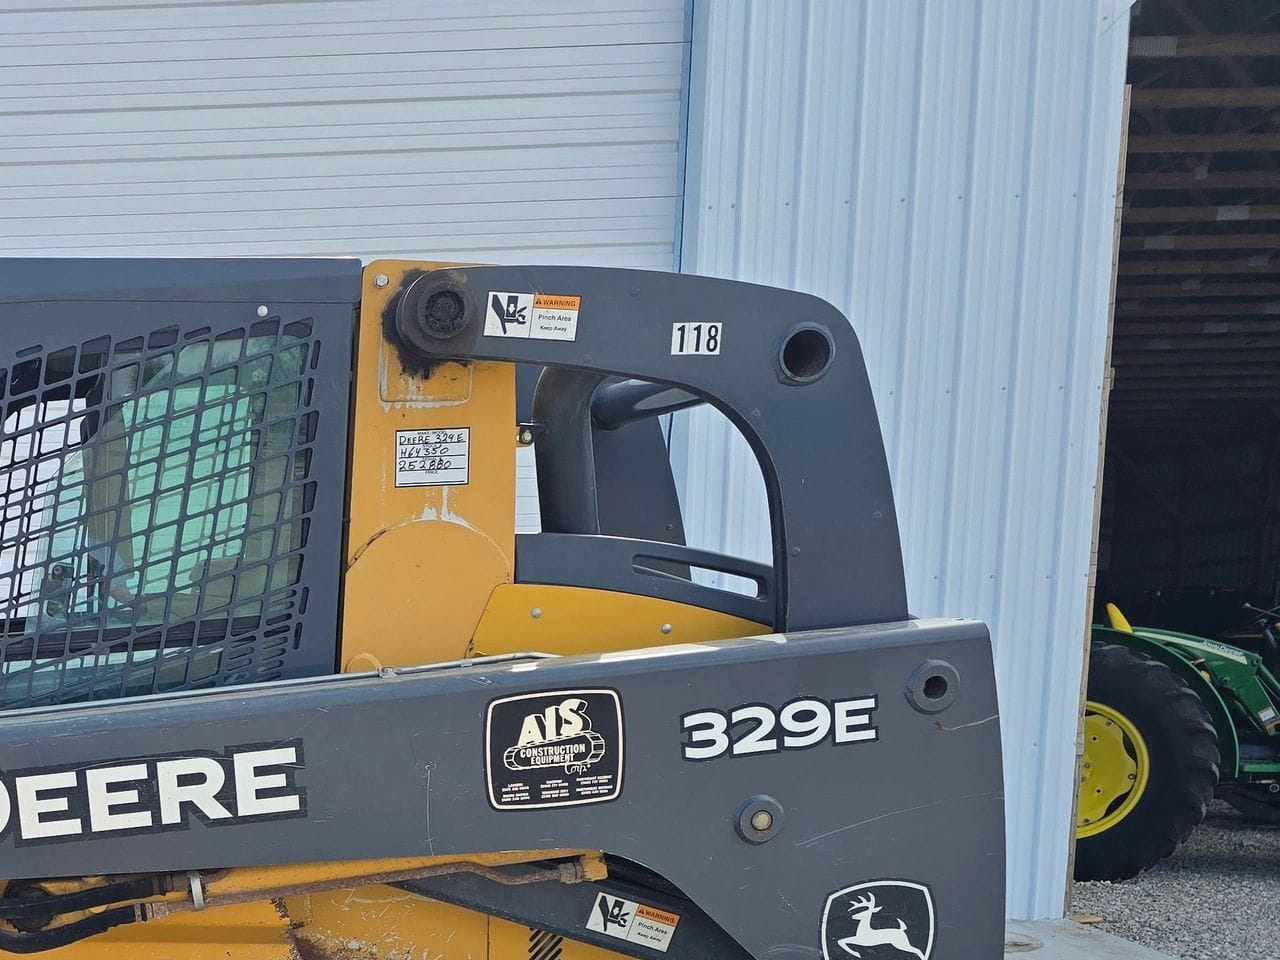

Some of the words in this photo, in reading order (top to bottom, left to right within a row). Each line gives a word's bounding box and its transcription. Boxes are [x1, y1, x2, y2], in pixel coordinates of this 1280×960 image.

[543, 299, 576, 307] WARNING
[677, 324, 719, 352] 118
[517, 699, 591, 746] AIS
[683, 698, 876, 759] 329E
[520, 743, 586, 759] CONSTRUCTION
[530, 753, 575, 765] EQUIPMENT
[645, 910, 675, 923] WARNING
[637, 922, 654, 932] Pinch
[654, 927, 668, 935] Area
[649, 935, 662, 943] Away
